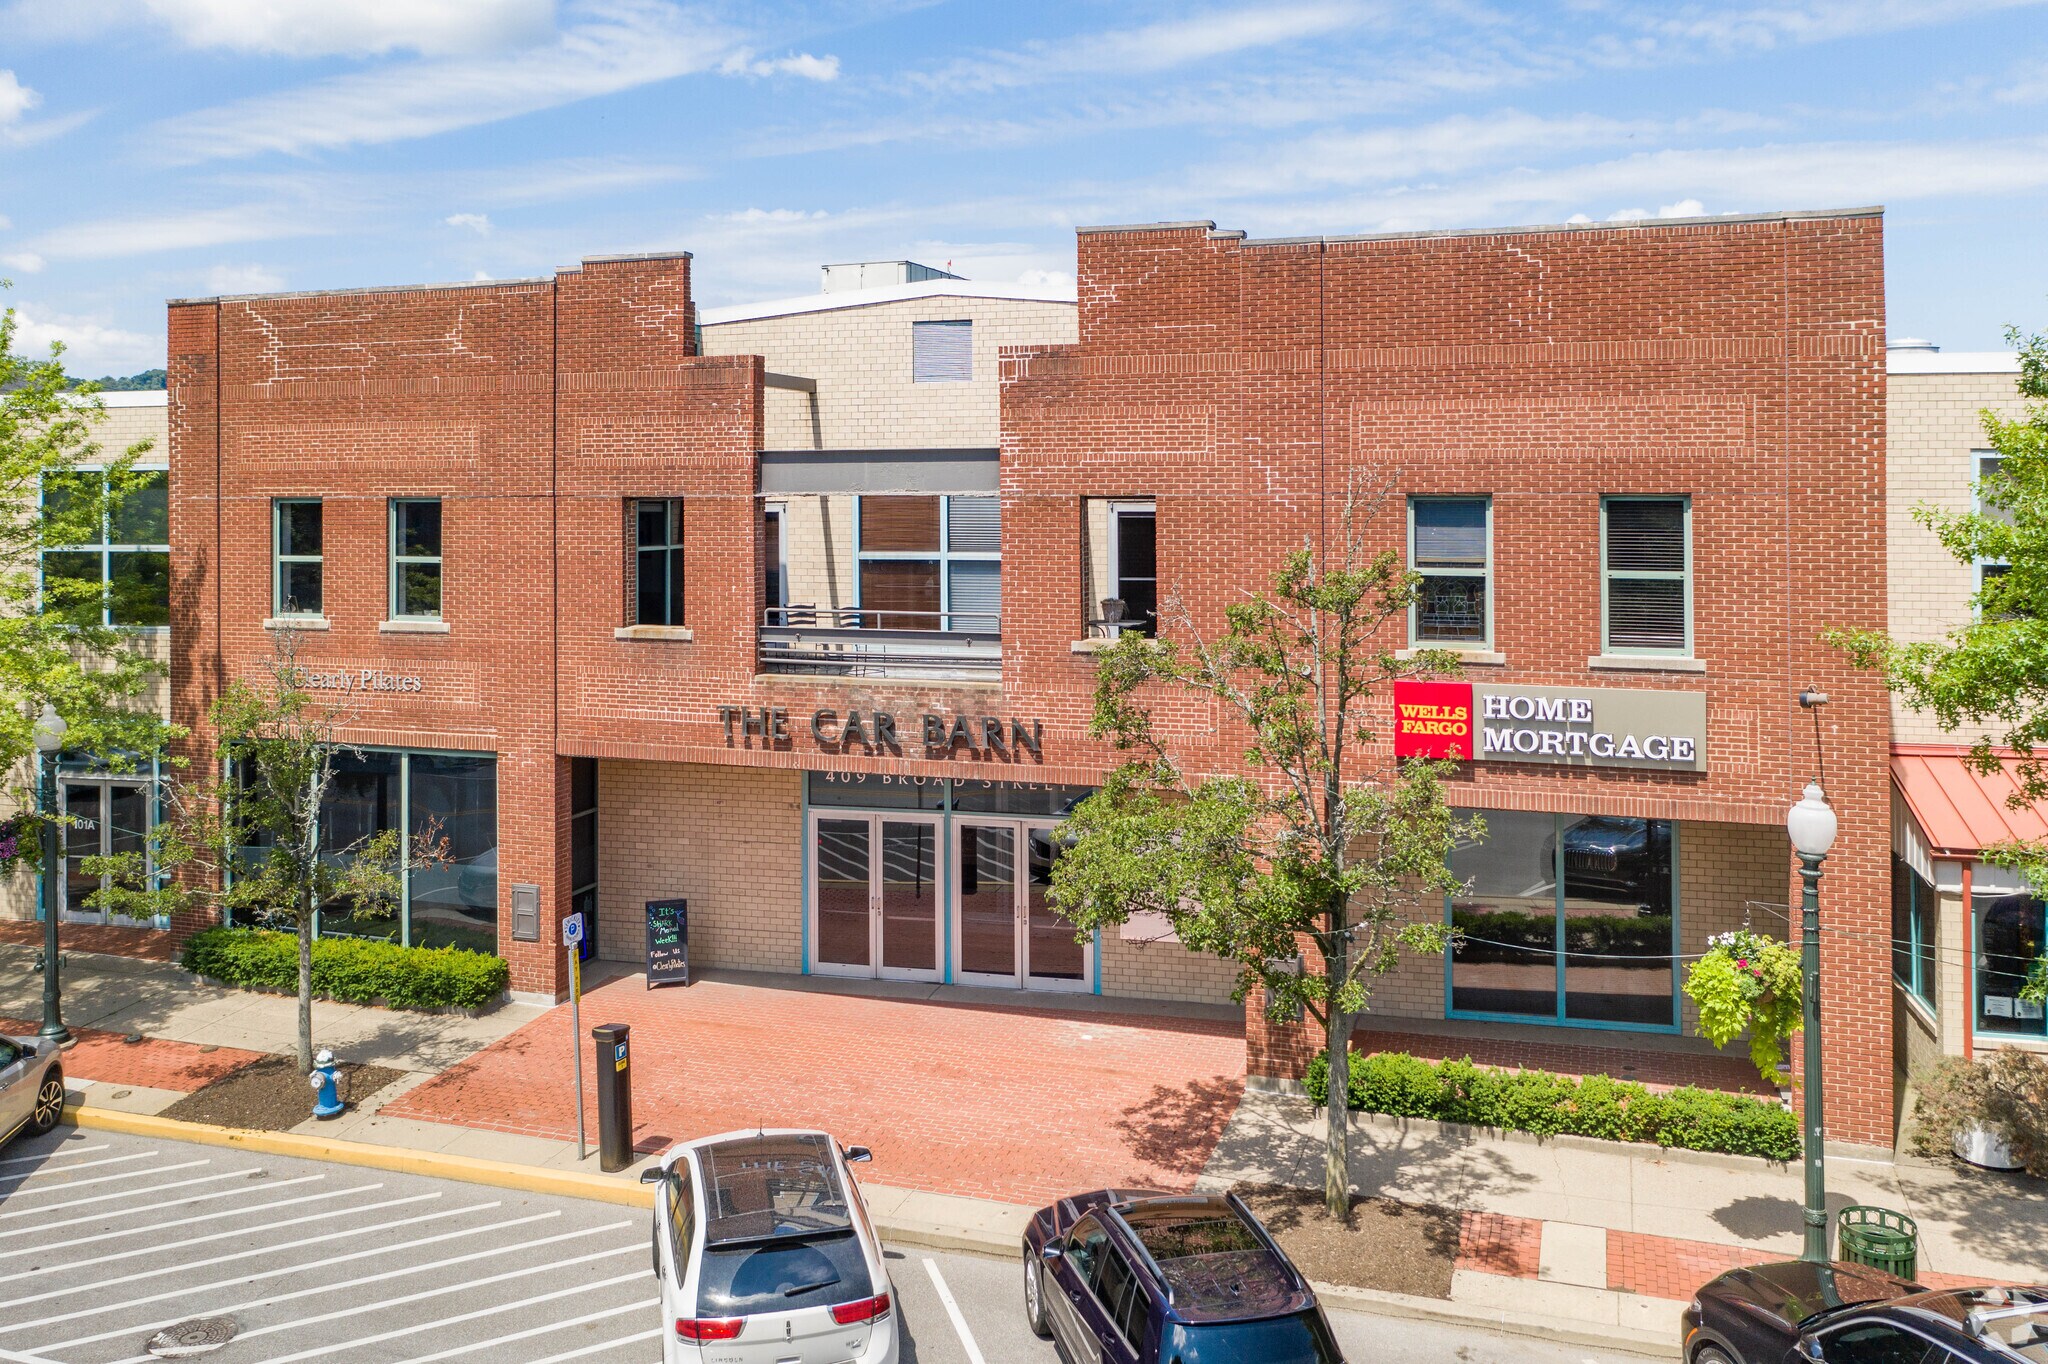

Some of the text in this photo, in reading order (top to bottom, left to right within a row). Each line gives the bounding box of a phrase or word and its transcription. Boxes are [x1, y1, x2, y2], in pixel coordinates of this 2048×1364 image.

[293, 667, 422, 696] Clearly Pilates
[1398, 704, 1468, 720] WELLS
[1482, 694, 1593, 723] HOME
[716, 705, 1041, 752] THE CAR BARN
[1401, 720, 1468, 737] FARGO
[1482, 727, 1696, 762] MORTGAGE
[825, 771, 866, 783] 409
[882, 774, 965, 787] BROAD
[74, 818, 96, 830] 101A
[658, 907, 675, 917] It's
[650, 950, 669, 958] Follow
[711, 1356, 744, 1364] LINCOLN
